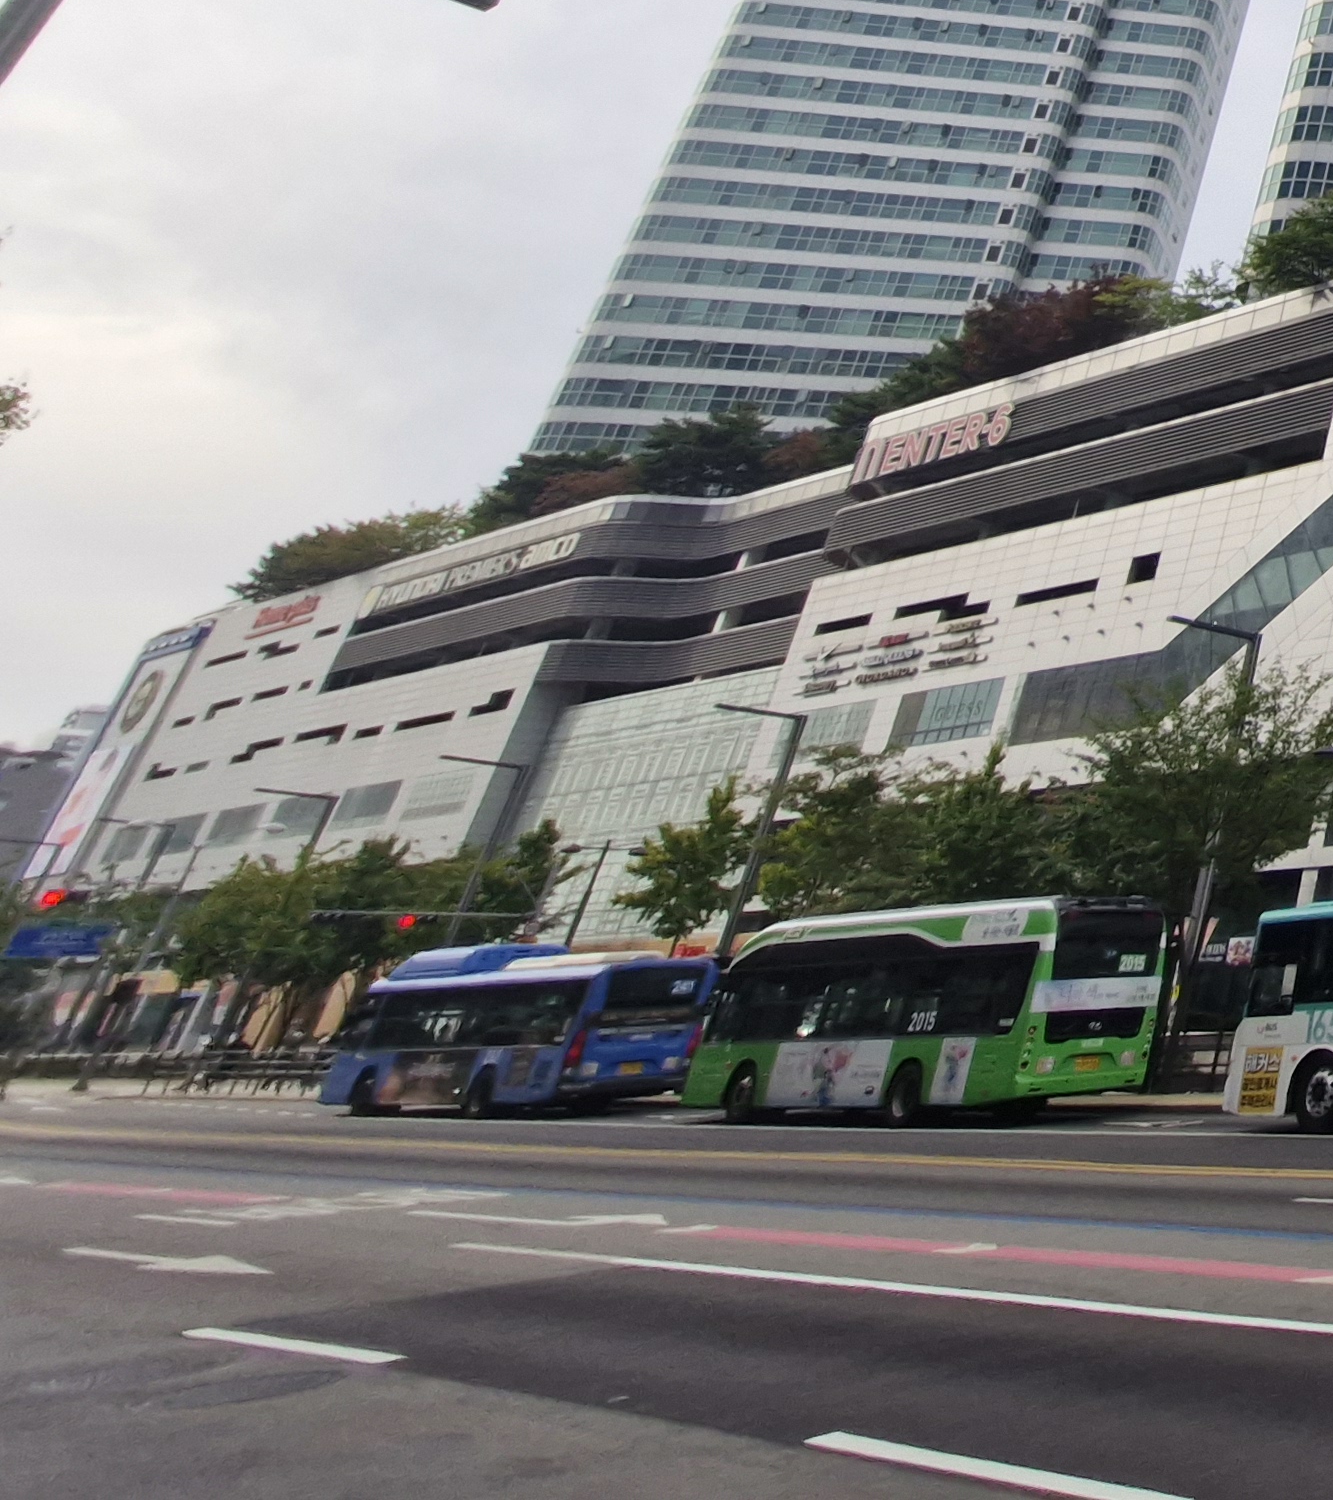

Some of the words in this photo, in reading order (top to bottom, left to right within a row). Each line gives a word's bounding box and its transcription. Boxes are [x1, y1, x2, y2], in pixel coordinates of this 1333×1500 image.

[1118, 954, 1146, 972] 2015
[907, 1011, 937, 1033] 2015
[1244, 1052, 1280, 1075] 해커스
